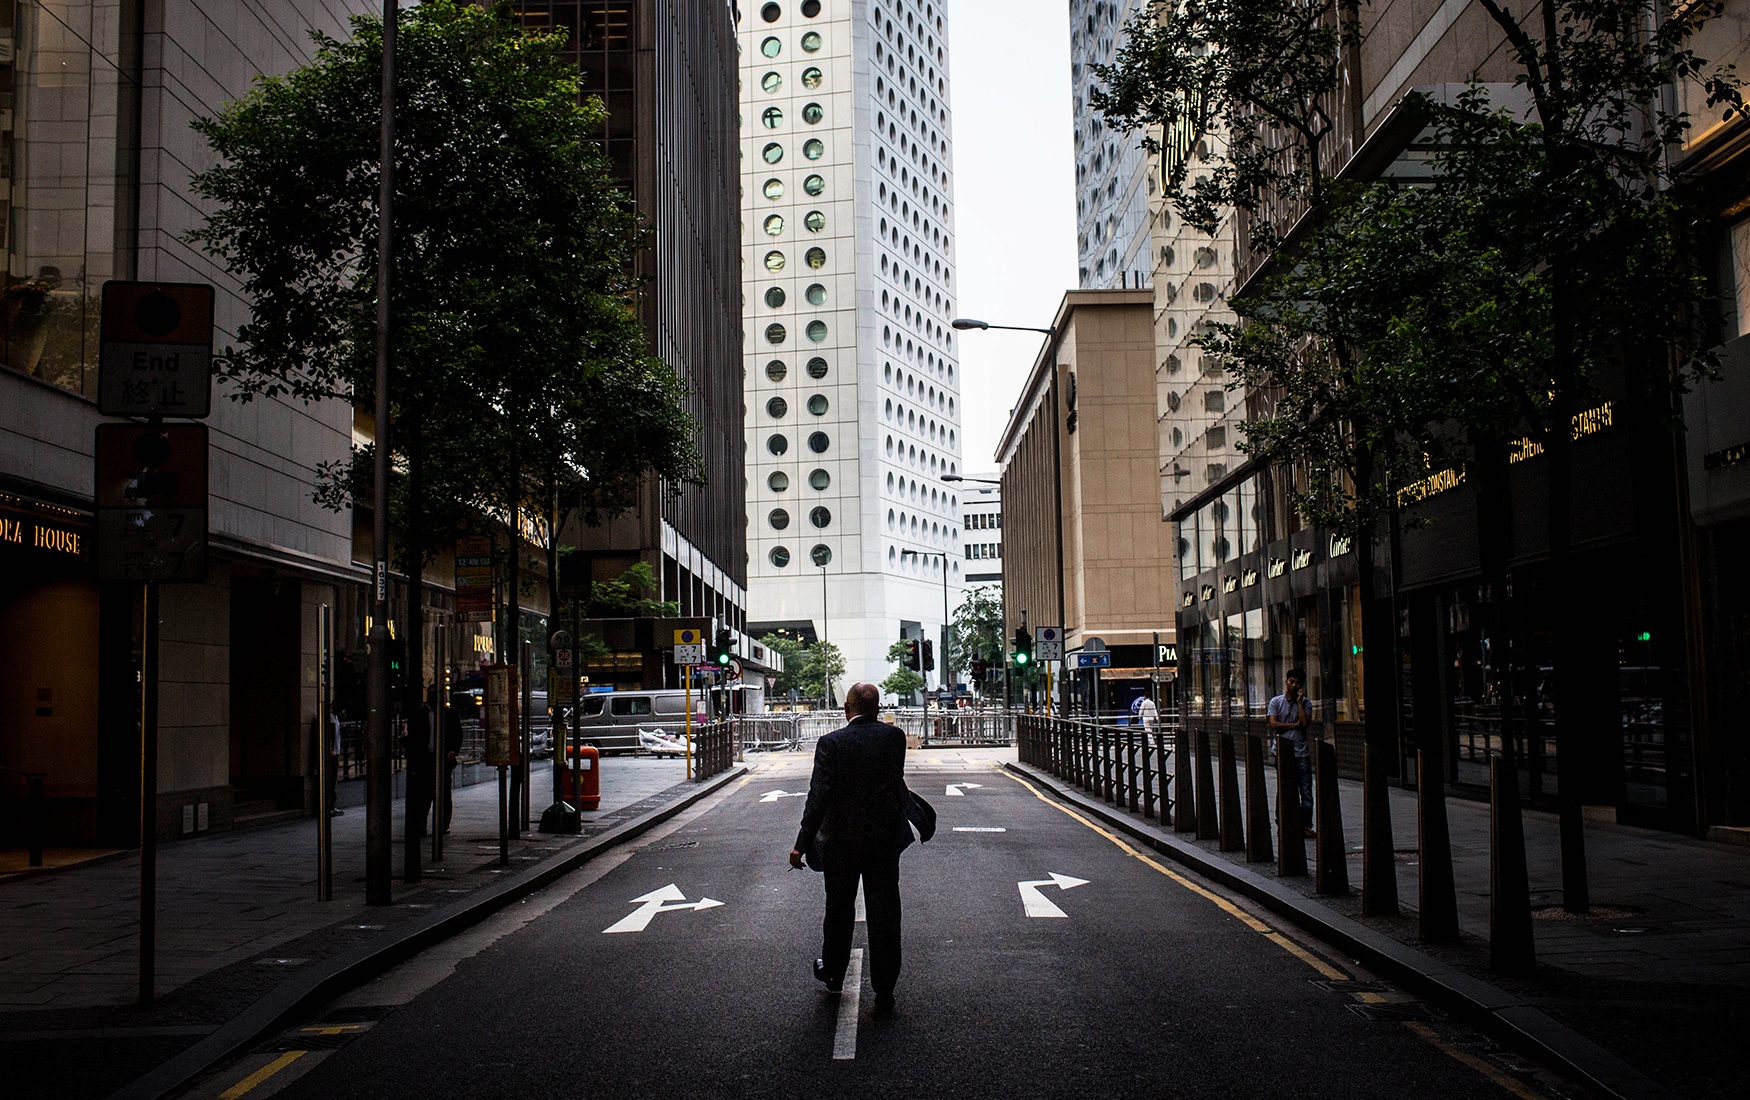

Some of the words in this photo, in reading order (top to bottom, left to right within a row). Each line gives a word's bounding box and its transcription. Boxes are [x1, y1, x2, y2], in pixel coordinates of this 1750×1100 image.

[134, 351, 180, 371] End
[121, 379, 186, 405] 終止
[1570, 401, 1613, 441] STANTIN
[0, 518, 23, 544] RA
[35, 525, 81, 555] HOUSE
[168, 513, 185, 537] 7
[168, 551, 185, 576] 7
[1291, 548, 1313, 571] Cartier
[459, 612, 468, 621] 13
